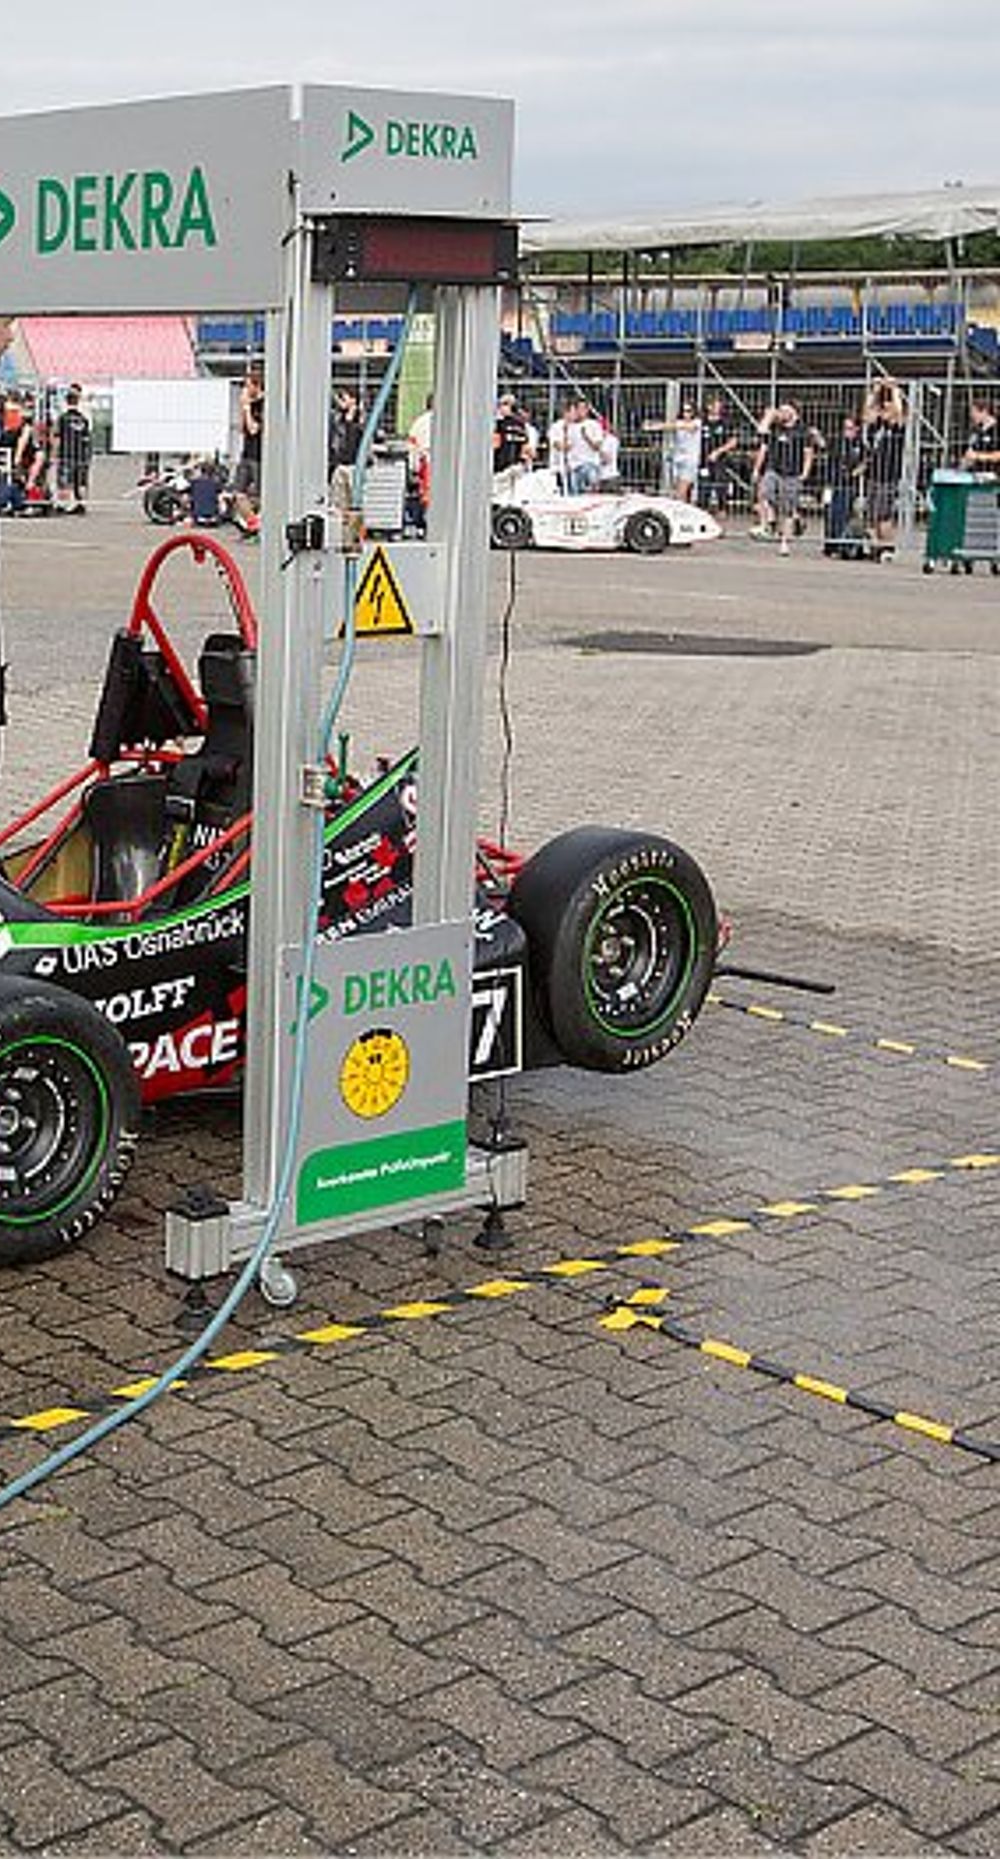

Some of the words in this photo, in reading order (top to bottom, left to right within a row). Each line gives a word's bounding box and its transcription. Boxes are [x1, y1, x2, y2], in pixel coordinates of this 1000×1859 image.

[387, 122, 475, 158] DEKRA
[37, 169, 215, 255] DEKRA
[62, 942, 119, 973] UAS
[123, 907, 245, 959] Osnabrück
[343, 959, 456, 1016] DEKRA
